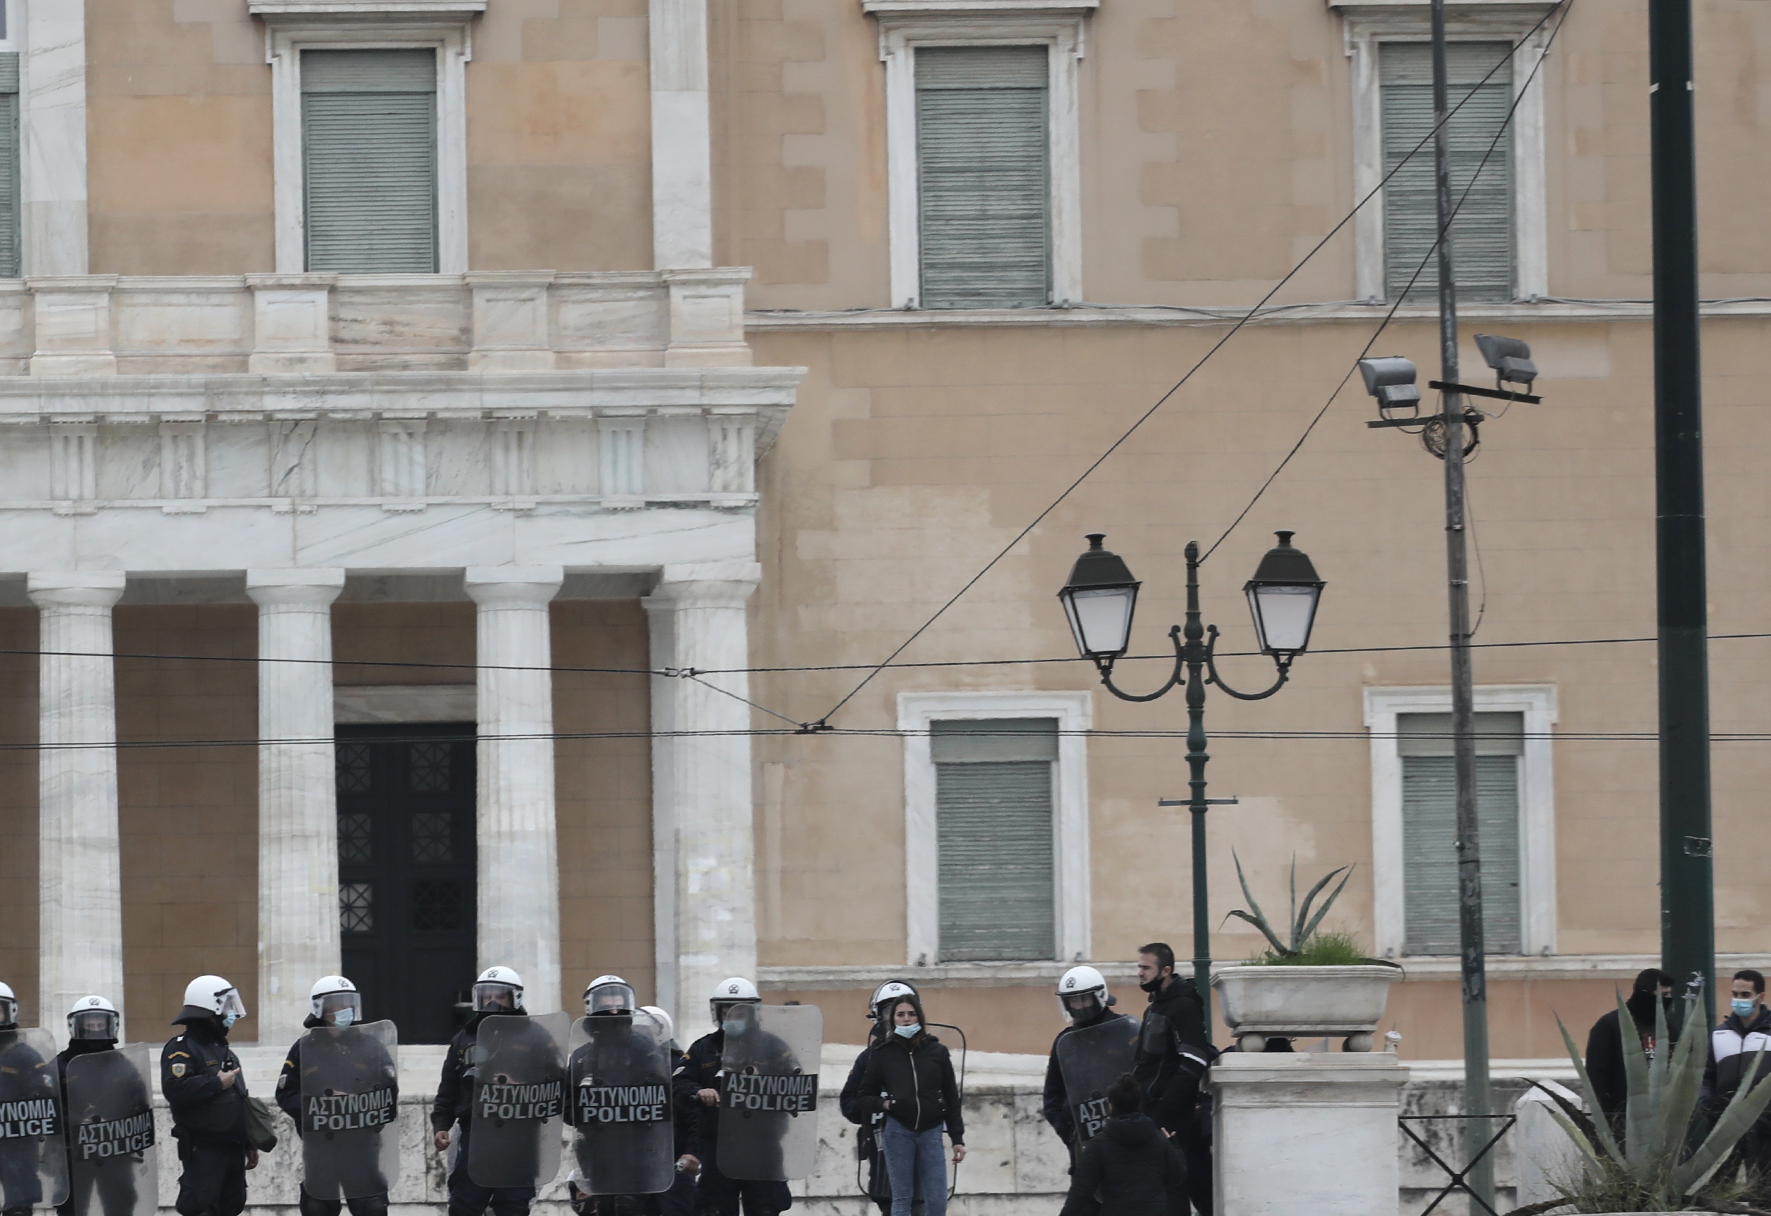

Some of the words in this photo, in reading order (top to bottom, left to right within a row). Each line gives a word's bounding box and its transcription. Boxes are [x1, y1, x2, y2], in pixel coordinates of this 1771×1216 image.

[479, 1081, 561, 1103] ΑΣΤΥΝΟΜΙΑ
[726, 1073, 814, 1095] ΑΣΤΥΝΟΜΙΑ
[308, 1088, 393, 1115] ΑΣΤΥΝΟΜΙΑ
[579, 1085, 667, 1106] ΑΣΤΥΝΟΜΙΑ
[730, 1093, 810, 1110] POLICE
[313, 1107, 390, 1130] POLICE
[483, 1100, 558, 1119] POLICE
[583, 1105, 663, 1123] POLICE
[78, 1112, 151, 1144] ΑΣΤΥΝΟΜΙΑ
[83, 1131, 151, 1160] POLICE
